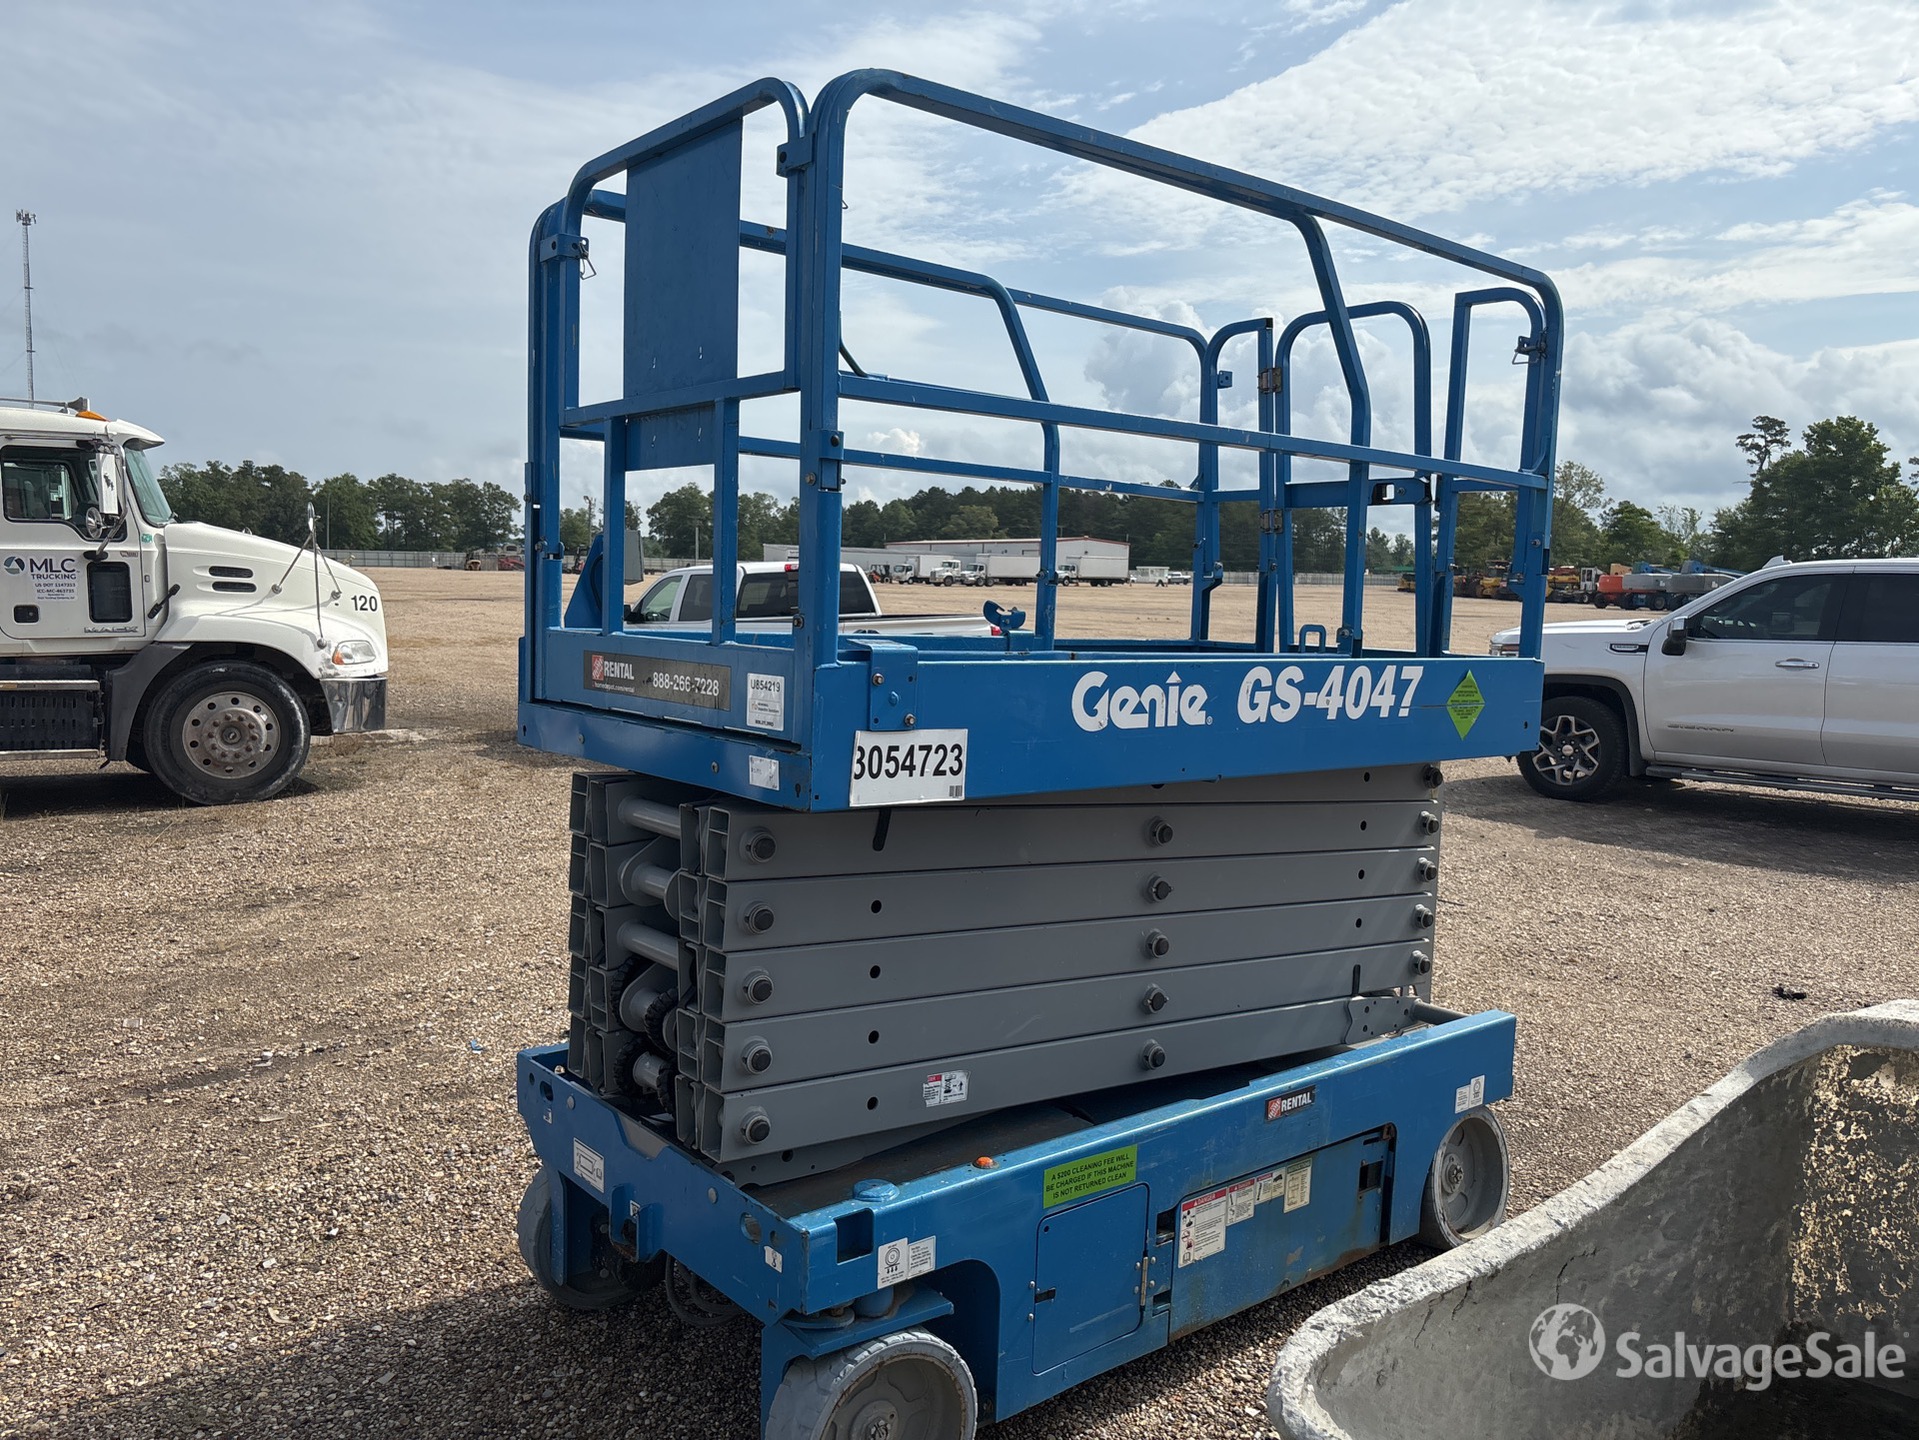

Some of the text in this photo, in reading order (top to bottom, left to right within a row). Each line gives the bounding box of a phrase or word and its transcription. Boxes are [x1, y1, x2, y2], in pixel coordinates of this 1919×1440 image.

[29, 558, 76, 573] MLC
[351, 595, 378, 612] 120
[604, 661, 635, 680] RENTAL
[652, 672, 720, 696] 888-266-7228
[750, 679, 781, 693] U854219
[1072, 670, 1208, 732] Genie
[1237, 665, 1424, 724] GS-4047
[853, 744, 963, 780] 3054723
[1281, 1092, 1312, 1112] RENTAL
[1046, 1160, 1134, 1192] BE CHARGED IF THIS MACHINE
[1057, 1170, 1071, 1179] $200
[1072, 1160, 1102, 1174] CLEANING
[1103, 1157, 1114, 1166] FEE
[1116, 1153, 1129, 1162] WILL
[1053, 1171, 1127, 1199] IS NOT RETURNED CLEAN
